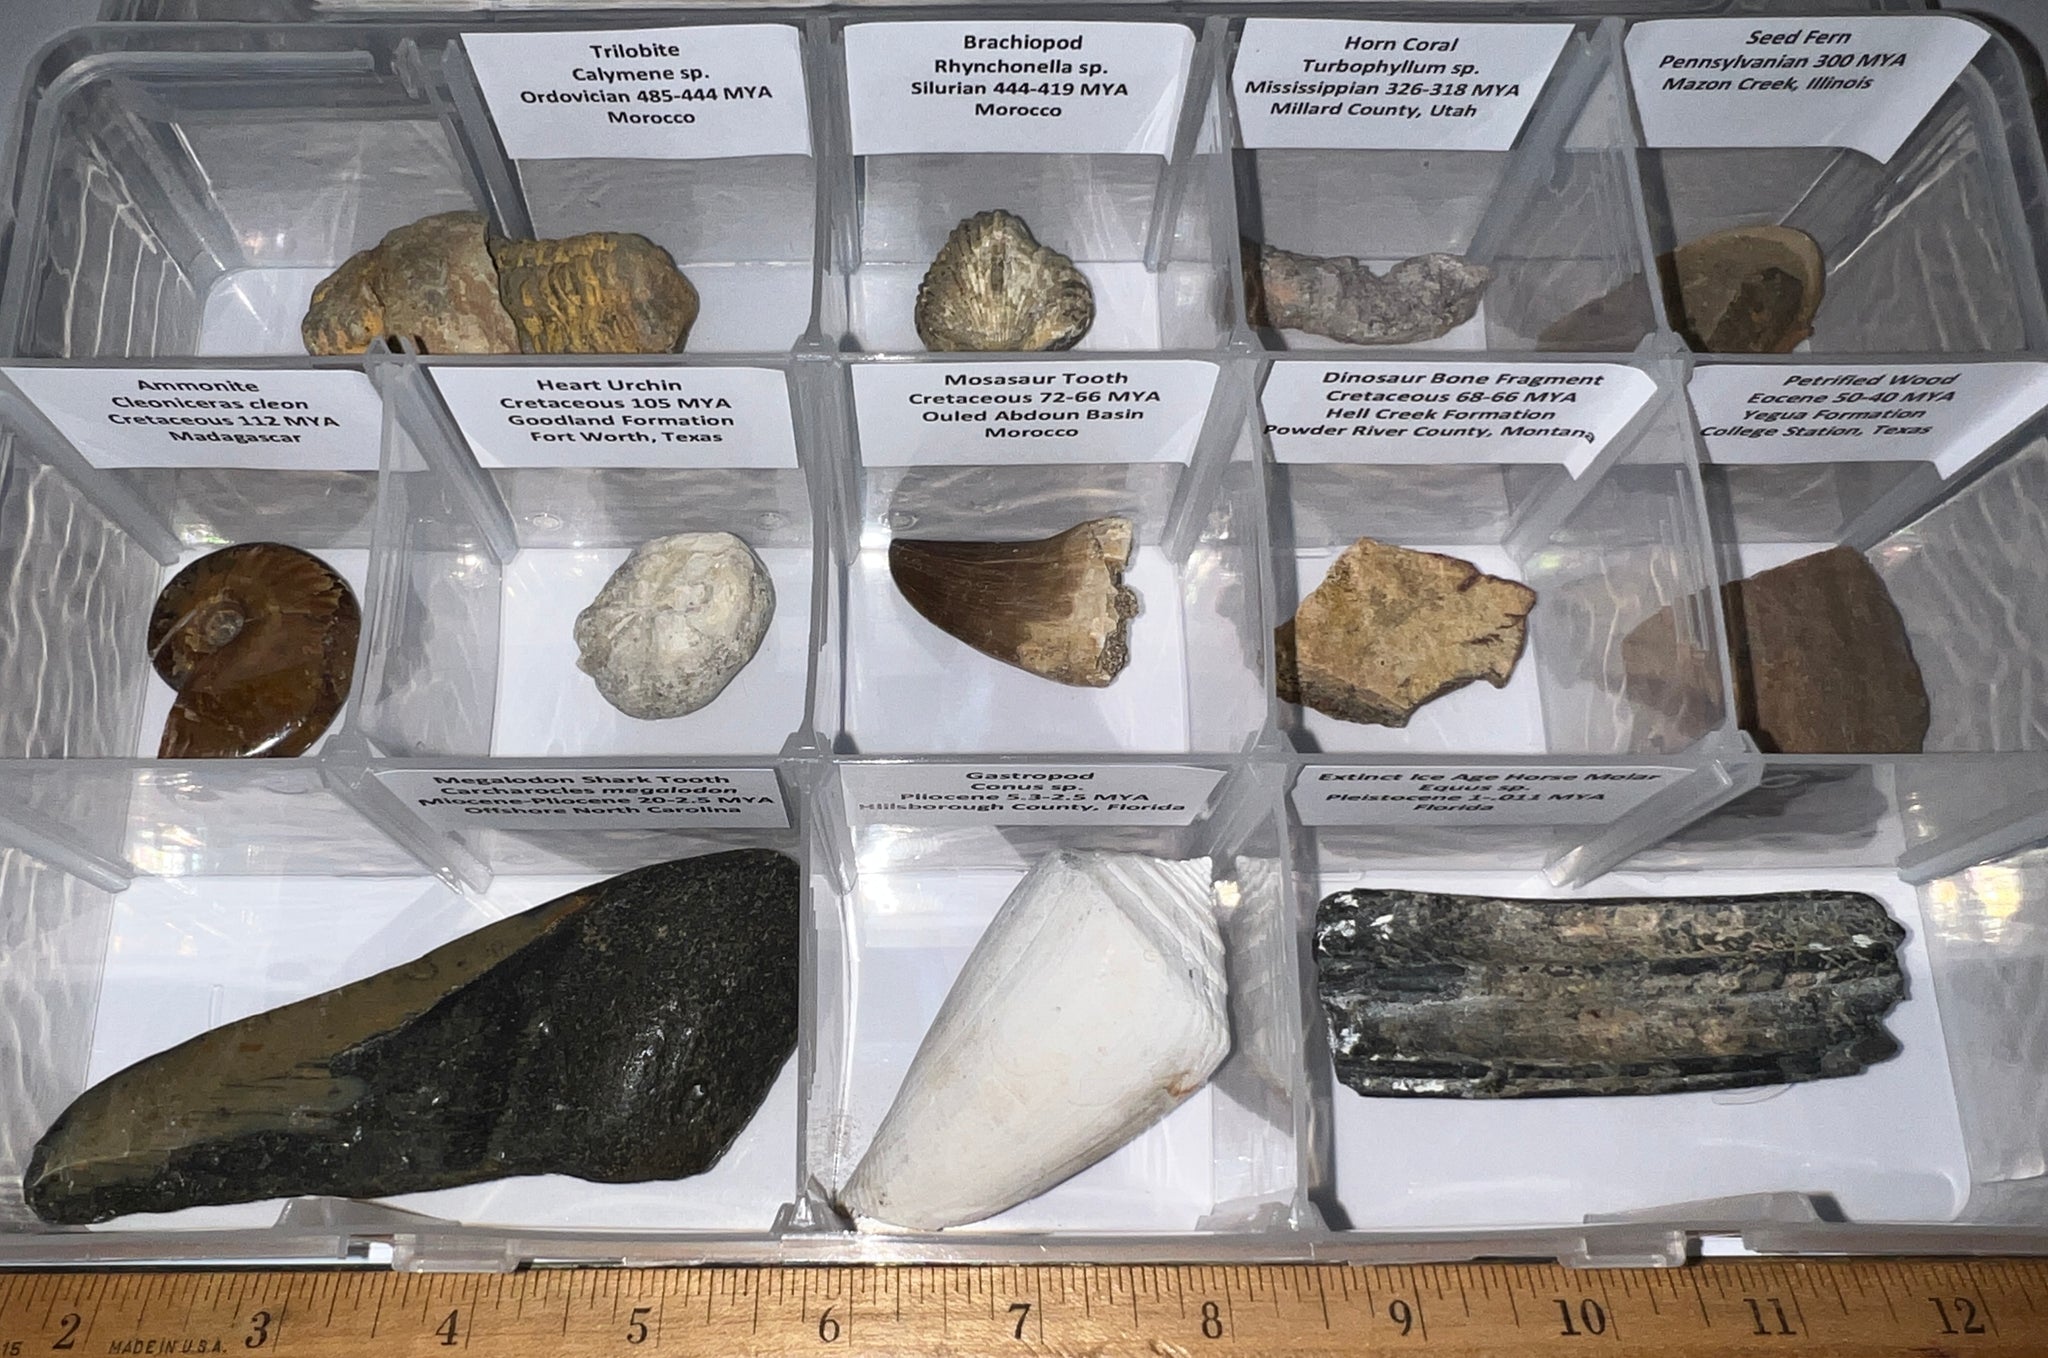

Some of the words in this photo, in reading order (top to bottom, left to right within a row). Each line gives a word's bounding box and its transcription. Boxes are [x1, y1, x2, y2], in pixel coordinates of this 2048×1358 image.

[963, 35, 1083, 53] Brachiopod
[1344, 36, 1396, 51] Horn
[1402, 37, 1459, 51] Coral
[1745, 30, 1802, 45] Seed
[1803, 31, 1852, 44] Fern
[589, 44, 680, 58] Trilobite
[935, 60, 1072, 76] Rhynchonella
[1079, 62, 1108, 76] sp.
[1302, 59, 1446, 76] Turbophyllum
[1450, 63, 1479, 77] sp.
[1659, 55, 1808, 71] Pennsylvanian
[1813, 54, 1854, 68] 300
[1856, 53, 1907, 67] MYA
[572, 68, 674, 84] Calymene
[680, 68, 709, 81] sp.
[911, 82, 986, 95] Silurian
[993, 83, 1074, 96] 444-419
[1080, 83, 1128, 96] MYA
[1245, 81, 1379, 97] Mississippian
[1385, 83, 1467, 96] 326-318
[1471, 85, 1520, 97] MYA
[1662, 78, 1732, 90] Mazon
[1737, 77, 1799, 92] Creek,
[1806, 77, 1875, 90] Illinois
[520, 90, 630, 104] Ordovician
[637, 88, 718, 103] 485-444
[724, 86, 772, 99] MYA
[975, 104, 1062, 117] Morocco
[1270, 103, 1341, 115] Millard
[1347, 104, 1422, 119] County,
[1430, 104, 1477, 117] Utah
[608, 111, 695, 124] Morocco
[537, 379, 602, 391] Heart
[608, 379, 682, 391] Urchin
[945, 374, 1056, 386] Mosasaur
[1063, 372, 1128, 385] Tooth
[1322, 372, 1427, 384] Dinosaur
[1430, 373, 1489, 385] Bone
[1495, 374, 1604, 388] Fragment
[1783, 375, 1887, 387] Petrified
[1890, 374, 1961, 385] Wood
[138, 380, 259, 392] Ammonite
[112, 396, 244, 409] Cleoniceras
[250, 398, 308, 410] cleon
[909, 393, 1032, 404] Cretaceous
[1040, 392, 1101, 403] 72-66
[1108, 391, 1160, 402] MYA
[1326, 391, 1450, 402] Cretaceous
[1455, 392, 1518, 402] 68-66
[1523, 392, 1577, 402] MYA
[1747, 393, 1826, 403] Eocene
[1832, 392, 1899, 403] 50-40
[1902, 392, 1956, 402] MYA
[500, 398, 624, 409] Cretaceous
[631, 399, 670, 409] 105
[677, 399, 732, 409] MYA
[108, 414, 234, 426] Cretaceous
[241, 416, 279, 426] 112
[286, 416, 340, 427] MYA
[508, 415, 614, 426] Goodland
[622, 415, 734, 426] Formation
[922, 411, 986, 422] Ouled
[994, 410, 1080, 421] Abdoun
[1086, 409, 1144, 420] Basin
[1326, 409, 1371, 419] Hell
[1375, 409, 1438, 420] Creek
[1442, 409, 1555, 420] Formation
[1743, 410, 1808, 422] Yegua
[1812, 409, 1927, 420] Formation
[169, 431, 301, 444] Madagascar
[530, 432, 575, 443] Fort
[580, 432, 656, 444] Worth,
[665, 432, 723, 443] Texas
[985, 427, 1079, 438] Morocco
[1263, 425, 1348, 435] Powder
[1352, 426, 1407, 437] River
[1413, 427, 1492, 439] County,
[1500, 427, 1595, 443] Montana
[1700, 427, 1779, 438] College
[1782, 426, 1864, 438] Station,
[1872, 425, 1934, 436] Texas
[433, 776, 576, 785] Megalodon
[581, 776, 652, 784] Shark
[661, 776, 729, 784] Tooth
[966, 772, 1094, 781] Gastropod
[1318, 773, 1403, 782] Extinct
[1410, 773, 1448, 781] Ice
[1453, 773, 1499, 782] Age
[1505, 773, 1580, 781] Horse
[1585, 773, 1661, 781] Molar
[441, 787, 596, 795] Carcharocles
[602, 787, 737, 795] megalodon
[970, 783, 1044, 791] Conus
[1050, 784, 1084, 792] sp.
[1418, 784, 1490, 792] Equus
[1497, 785, 1530, 793] sp.
[418, 797, 631, 807] Miocene-Pliocene
[900, 793, 999, 801] Pliocene
[1008, 793, 1086, 801] 5.3-2.5
[1547, 793, 1605, 801] MYA
[464, 806, 566, 815] Offshore
[859, 803, 1003, 812] Hillsborough
[1012, 803, 1099, 812] County,
[1107, 803, 1186, 811] Florida
[1008, 1303, 1031, 1340] 7
[1202, 1301, 1223, 1339] 8
[1389, 1300, 1412, 1336] 9
[1556, 1298, 1606, 1335] 10
[1743, 1298, 1797, 1335] 11
[1928, 1297, 1985, 1334] 12
[52, 1312, 81, 1349] 2
[245, 1311, 270, 1348] 3
[435, 1309, 459, 1346] 4
[627, 1307, 652, 1344] 5
[819, 1306, 840, 1342] 6
